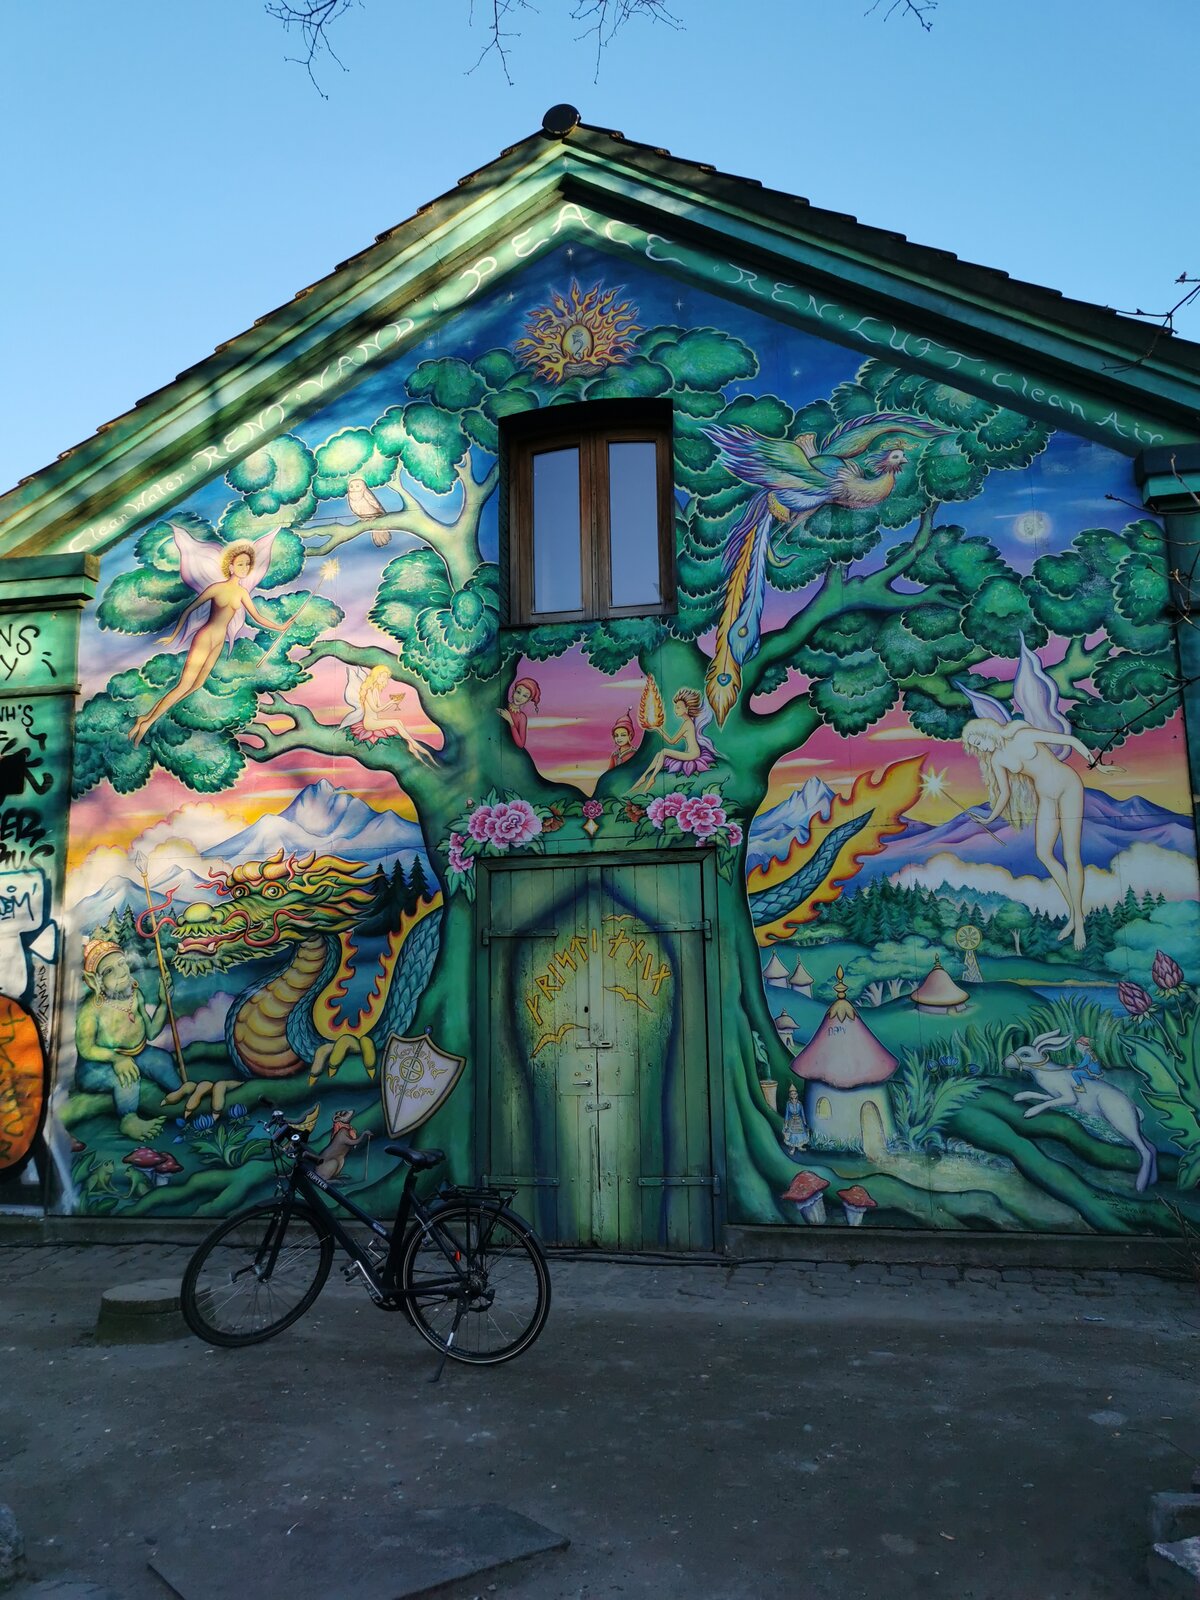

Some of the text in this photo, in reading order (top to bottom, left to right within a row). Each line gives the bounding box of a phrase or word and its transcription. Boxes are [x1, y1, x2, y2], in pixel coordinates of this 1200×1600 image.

[68, 203, 1164, 551] Clean Water RENT VAND PEACE REN LUFT Clean Air
